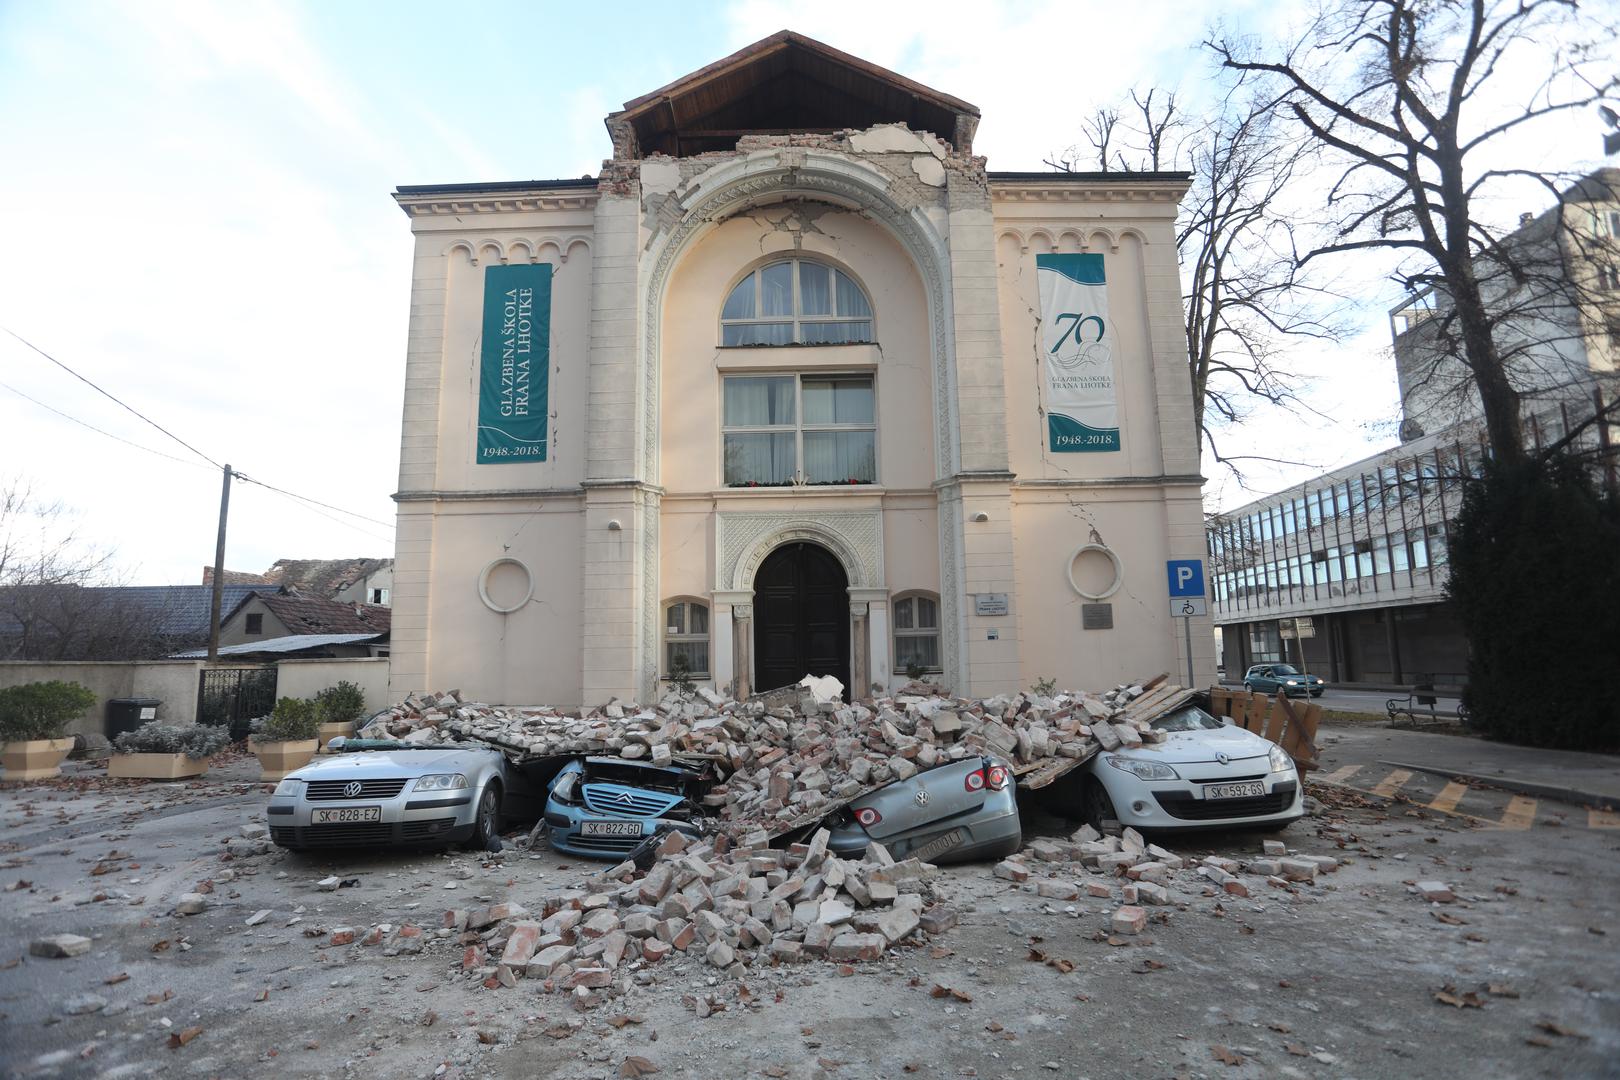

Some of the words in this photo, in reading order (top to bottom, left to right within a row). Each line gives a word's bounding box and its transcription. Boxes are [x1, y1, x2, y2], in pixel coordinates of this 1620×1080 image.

[501, 289, 517, 335] ŠKOLA
[518, 288, 532, 353] LHOTKE
[501, 339, 514, 416] GLAZBENA
[515, 359, 530, 415] FRANA
[1177, 566, 1193, 590] P
